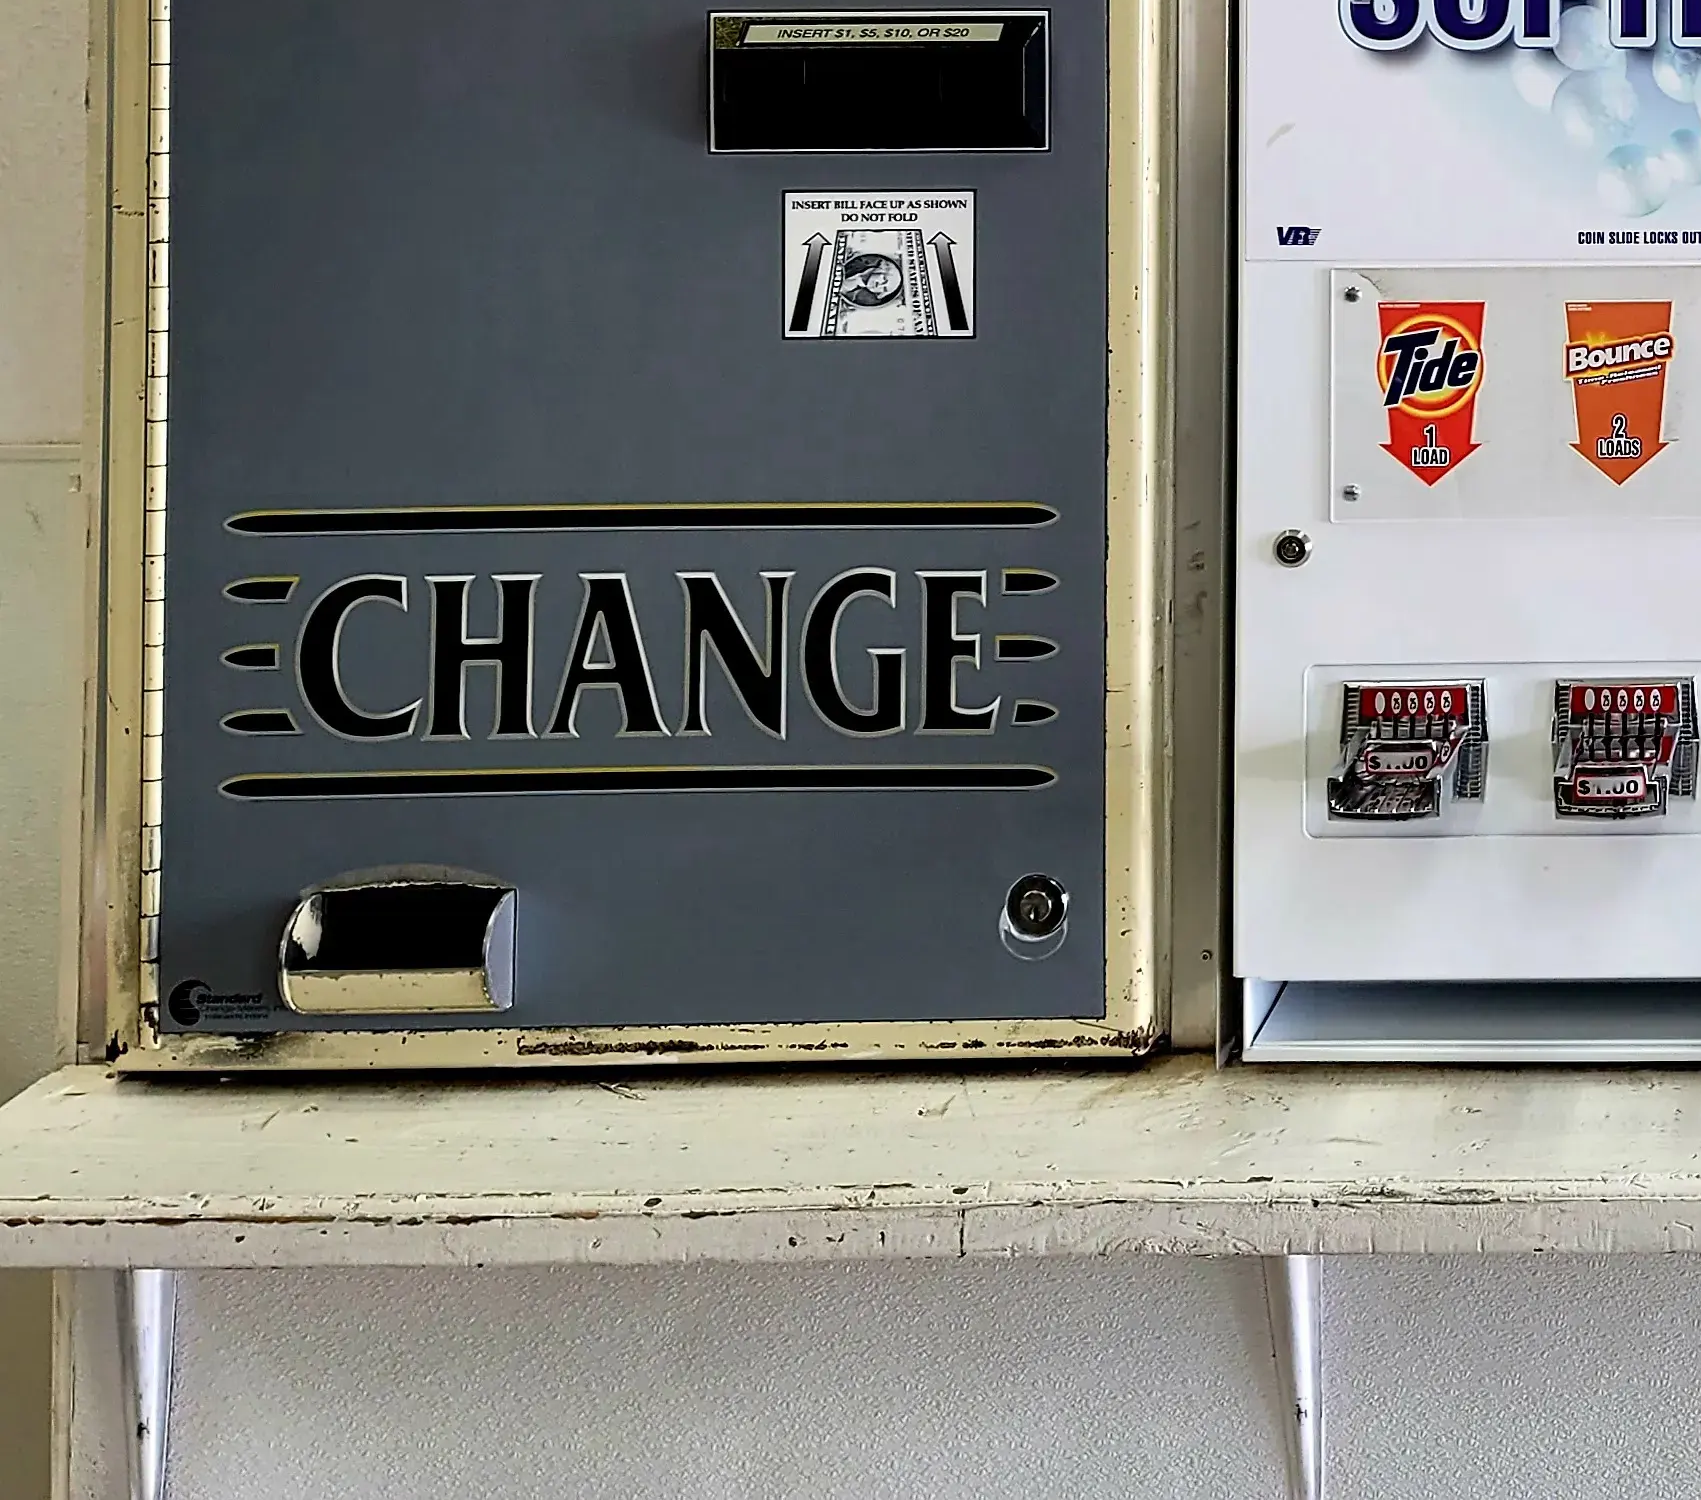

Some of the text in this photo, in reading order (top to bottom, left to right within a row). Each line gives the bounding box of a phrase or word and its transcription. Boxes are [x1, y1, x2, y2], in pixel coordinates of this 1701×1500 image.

[777, 29, 833, 39] INSERT
[917, 28, 940, 38] OR
[792, 200, 967, 210] INSERT BILL FACE UP AS SHOWN
[841, 213, 918, 223] DO NOT FOLD
[1578, 231, 1605, 245] COIN
[1608, 231, 1640, 245] SLIDE
[1643, 231, 1678, 245] LOCKS
[1569, 336, 1671, 372] Bounce
[1383, 327, 1480, 407] Tide
[1612, 414, 1626, 438] 2
[1423, 423, 1438, 448] 1
[1412, 448, 1449, 466] LOAD
[1599, 439, 1641, 457] LOADS
[296, 566, 1002, 741] CHANGE
